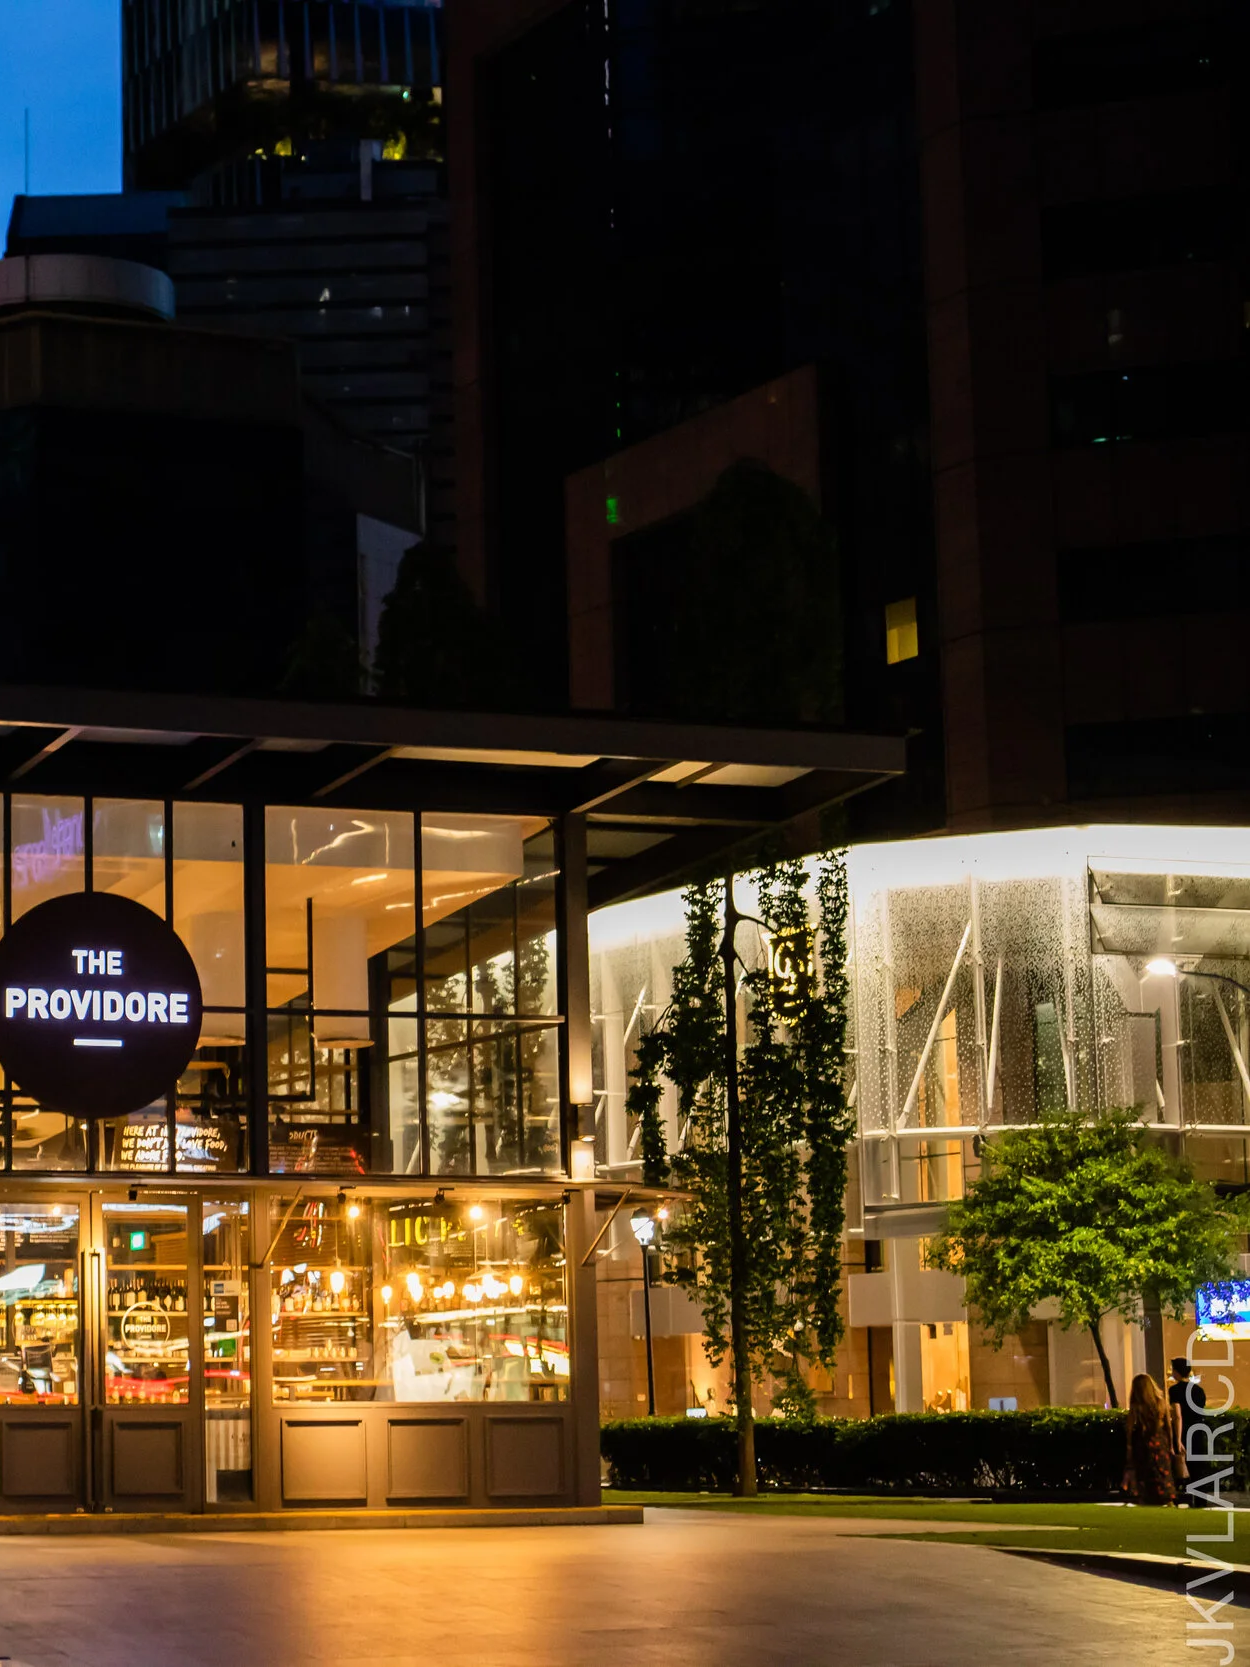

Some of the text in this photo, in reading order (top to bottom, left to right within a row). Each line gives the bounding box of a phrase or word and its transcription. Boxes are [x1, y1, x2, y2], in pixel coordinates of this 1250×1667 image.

[71, 949, 123, 975] THE
[5, 987, 189, 1024] PROVIDORE
[123, 1125, 145, 1137] HERE
[145, 1124, 160, 1137] AT
[122, 1137, 135, 1149] WE
[121, 1150, 134, 1161] WE
[139, 1315, 152, 1323] THE
[125, 1324, 167, 1333] PROVIDORE
